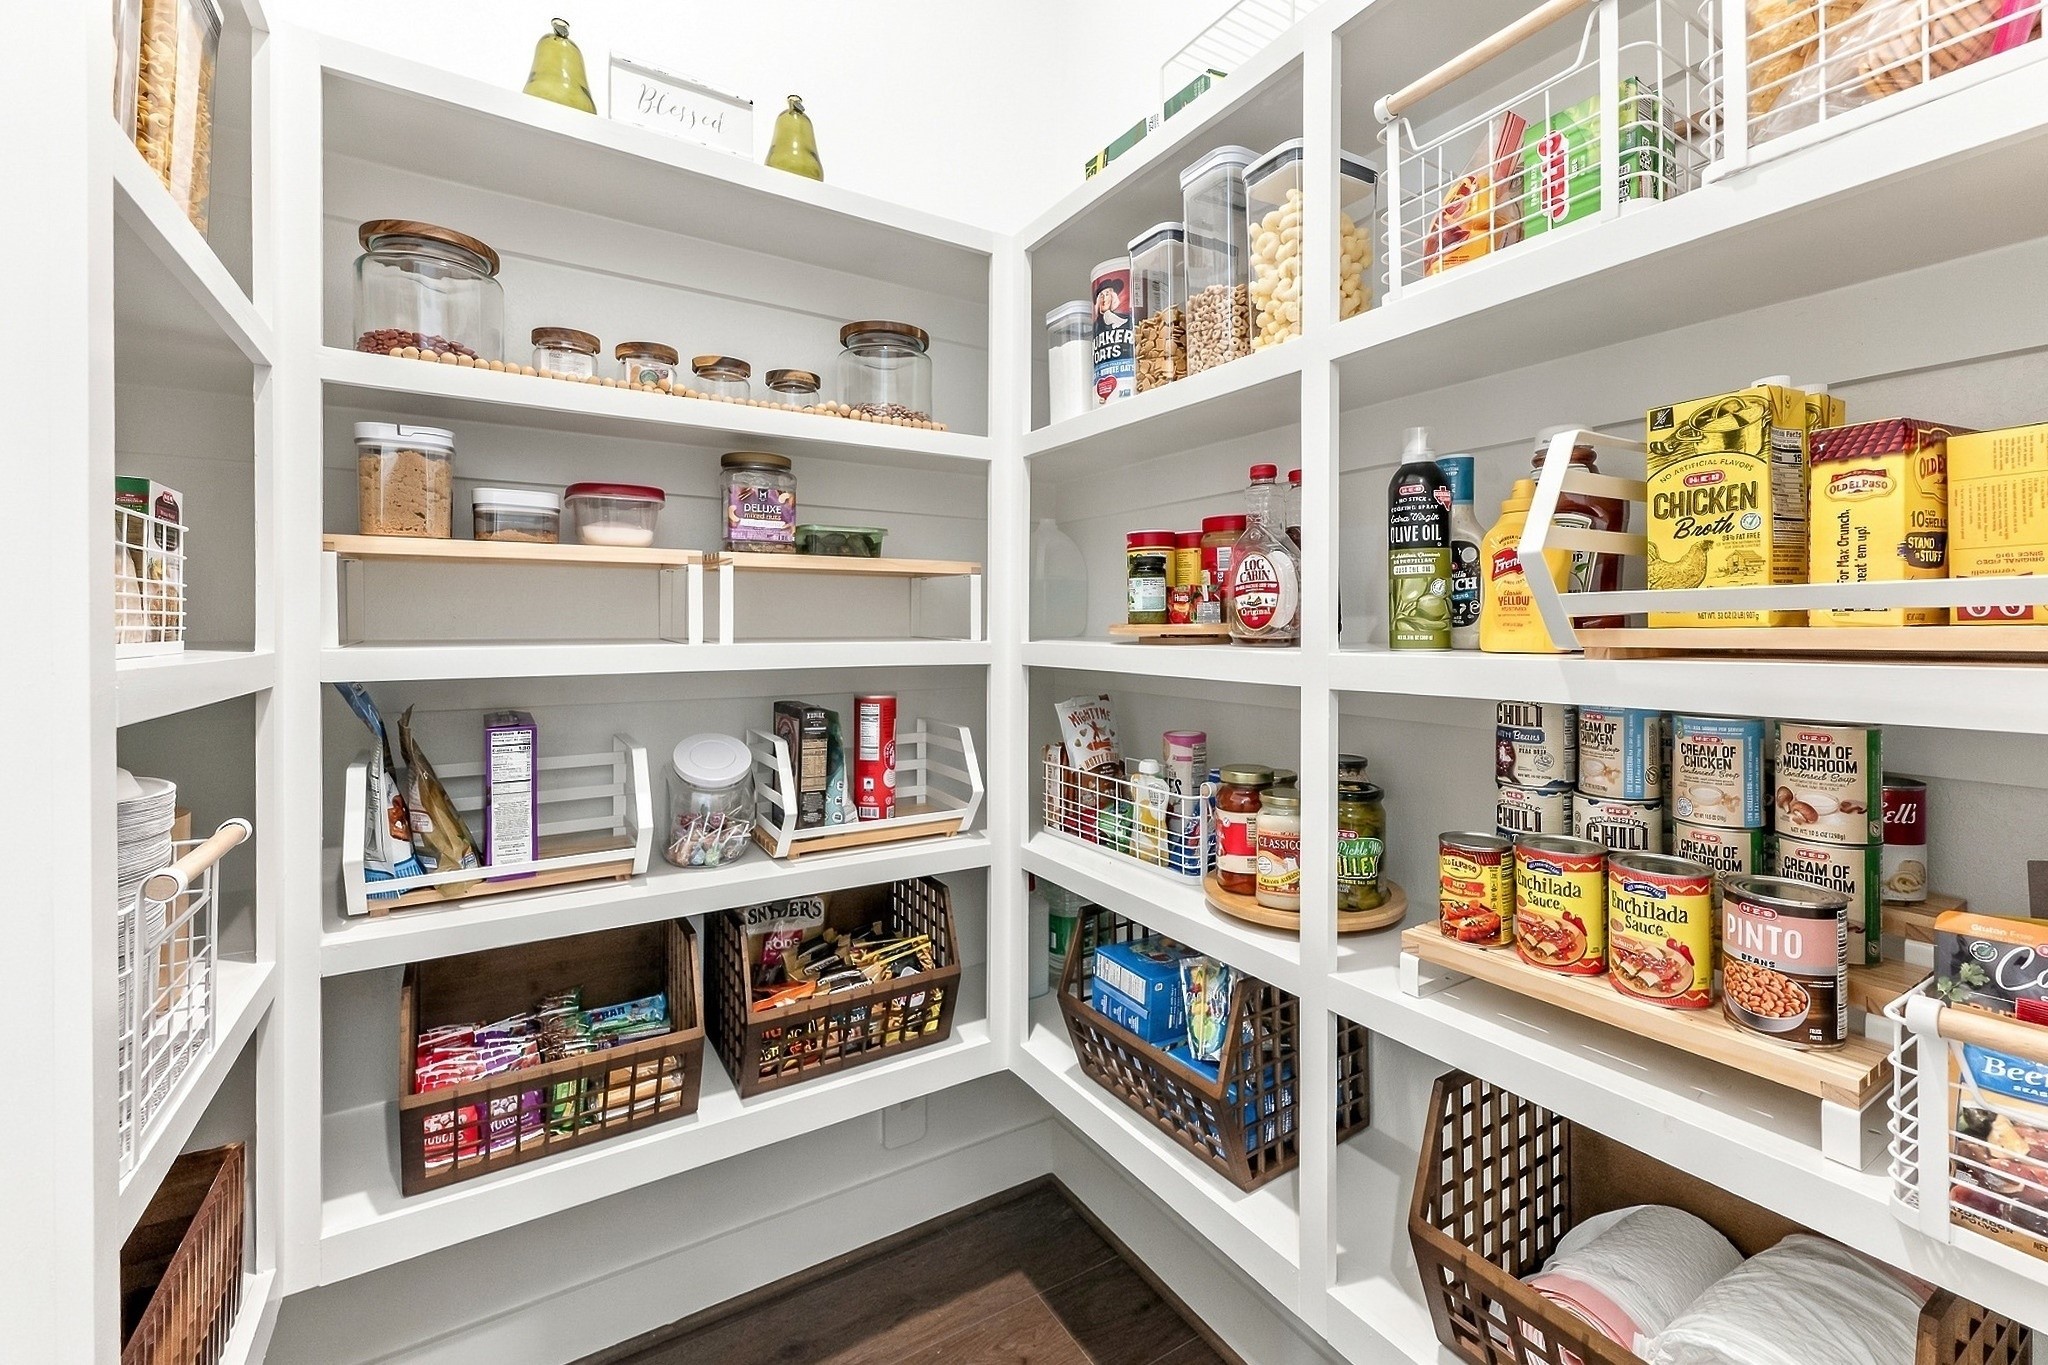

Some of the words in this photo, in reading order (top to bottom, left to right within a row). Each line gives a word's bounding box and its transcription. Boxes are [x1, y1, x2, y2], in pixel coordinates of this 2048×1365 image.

[637, 83, 724, 133] Blessed
[1094, 344, 1122, 364] OATS
[1674, 459, 1718, 474] ARTIFICIAL
[1720, 458, 1754, 472] FLAVORS
[1829, 482, 1848, 495] OLD
[1848, 480, 1861, 489] EL
[743, 503, 782, 514] DELUXE
[1653, 480, 1759, 521] CHICKEN
[1673, 512, 1735, 539] Broth
[1837, 508, 1851, 547] Crunch,
[1911, 510, 1925, 528] 10
[1390, 525, 1419, 544] OLIVE
[1422, 524, 1442, 541] OIL
[1854, 526, 1871, 544] up!
[1908, 537, 1935, 549] STAND
[1244, 558, 1265, 571] LOG
[1837, 549, 1850, 568] Max
[1920, 551, 1943, 562] STUFF
[1240, 570, 1270, 583] CABIN
[1498, 596, 1530, 606] YELLOW
[1241, 606, 1272, 616] Original
[1496, 700, 1543, 728] CHILI
[1512, 730, 1540, 741] Beans
[1603, 723, 1617, 735] OF
[1680, 742, 1718, 758] CREAM
[1722, 745, 1737, 758] OF
[1785, 742, 1830, 759] CREAM
[1835, 746, 1853, 760] OF
[1684, 755, 1732, 770] CHICKEN
[1783, 755, 1858, 774] MUSHROOM
[1783, 767, 1827, 781] Condensed
[1830, 773, 1856, 786] Soup
[1496, 803, 1542, 833] CHILI
[1586, 822, 1649, 850] CHILI
[1338, 840, 1368, 856] Pickle
[1680, 838, 1719, 858] CREAM
[1722, 846, 1738, 859] OF
[1784, 856, 1828, 877] CREAM
[1832, 865, 1851, 879] OF
[1517, 868, 1582, 899] Enchilada
[1527, 892, 1560, 910] Sauce
[1611, 890, 1689, 924] Enchilada
[1625, 914, 1664, 937] Sauce
[1970, 923, 2007, 936] Gluten
[1727, 912, 1803, 959] PINTO
[1741, 952, 1776, 968] BEANS
[1950, 1206, 2014, 1234] AZONADOR
[1960, 1216, 1999, 1233] POLVO
